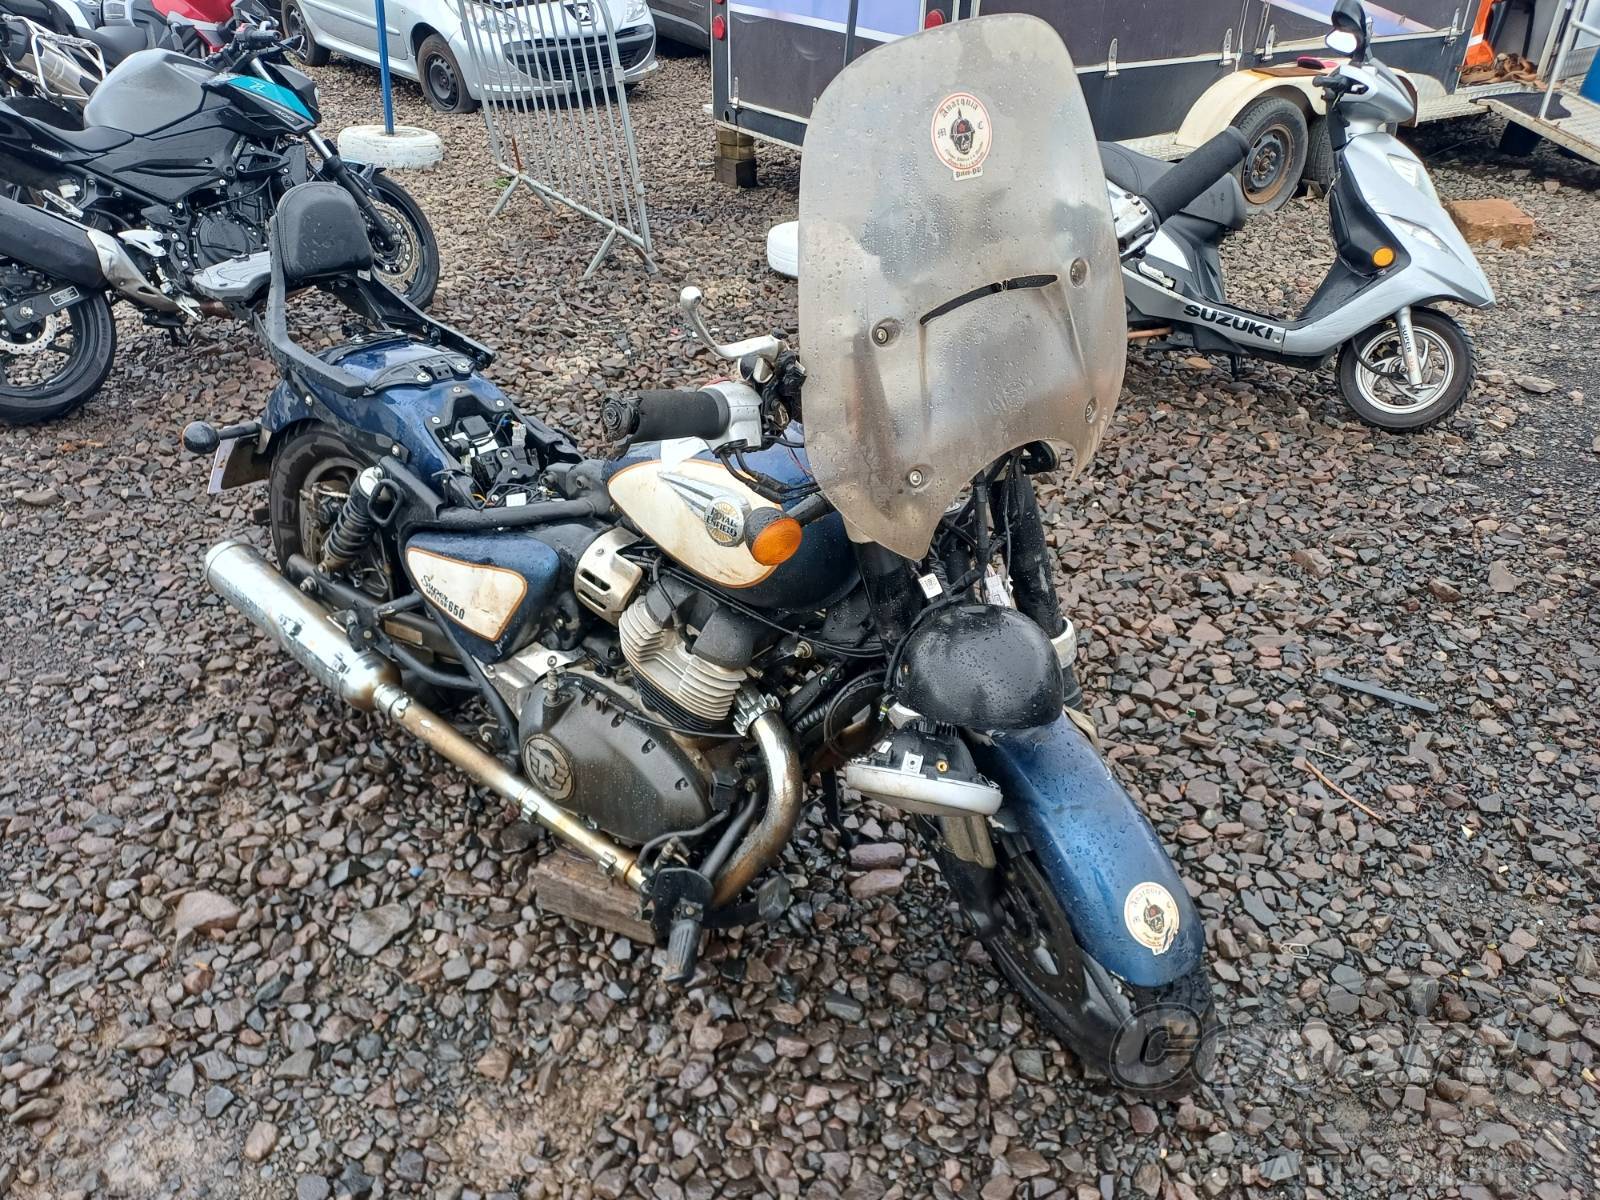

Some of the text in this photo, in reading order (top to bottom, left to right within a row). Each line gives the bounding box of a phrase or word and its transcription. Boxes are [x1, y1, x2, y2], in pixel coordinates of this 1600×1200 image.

[1183, 304, 1274, 340] SUZUKI
[706, 515, 738, 538] ENFIELD
[710, 506, 739, 528] ROYAL
[447, 600, 466, 620] 650
